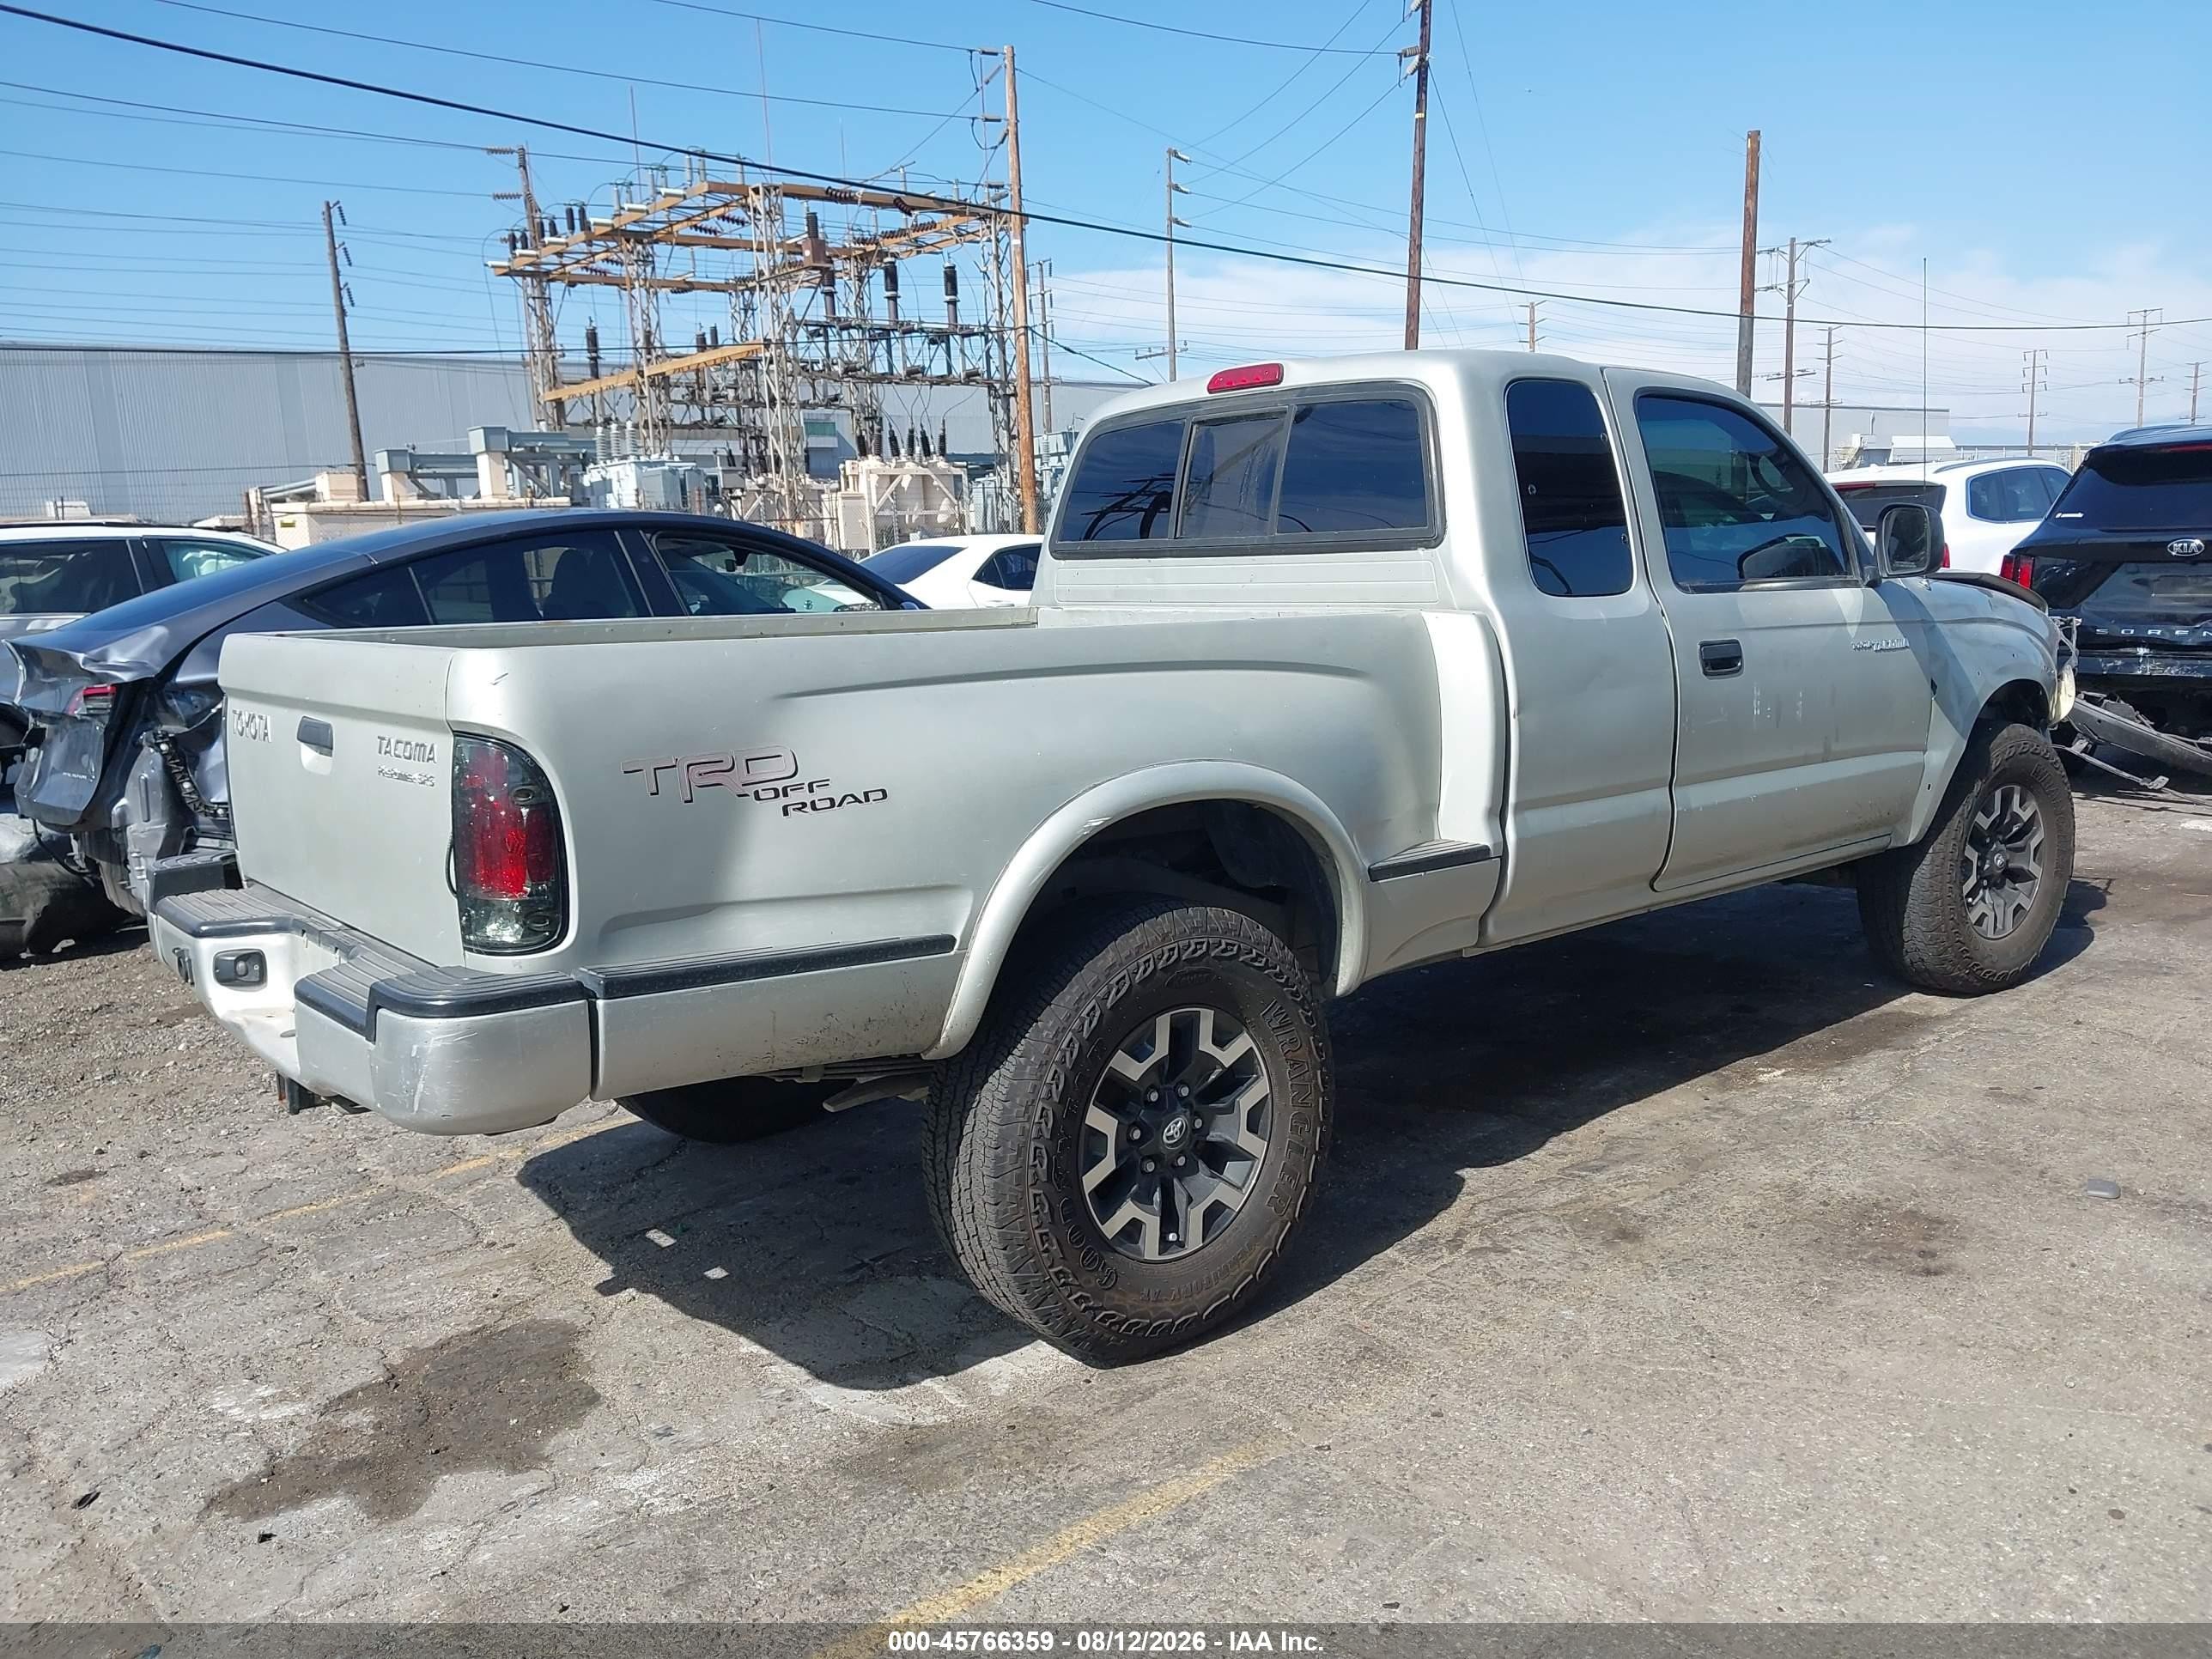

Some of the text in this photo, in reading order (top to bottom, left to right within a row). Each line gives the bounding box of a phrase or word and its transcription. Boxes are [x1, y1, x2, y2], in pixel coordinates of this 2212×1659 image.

[2172, 543, 2200, 554] KIA
[232, 708, 272, 744] TOYOTA
[377, 735, 438, 763] TACOMA
[621, 744, 799, 804] TRD
[752, 778, 831, 802] OFF
[781, 787, 888, 817] ROAD
[1260, 998, 1313, 1218] WRANGLER
